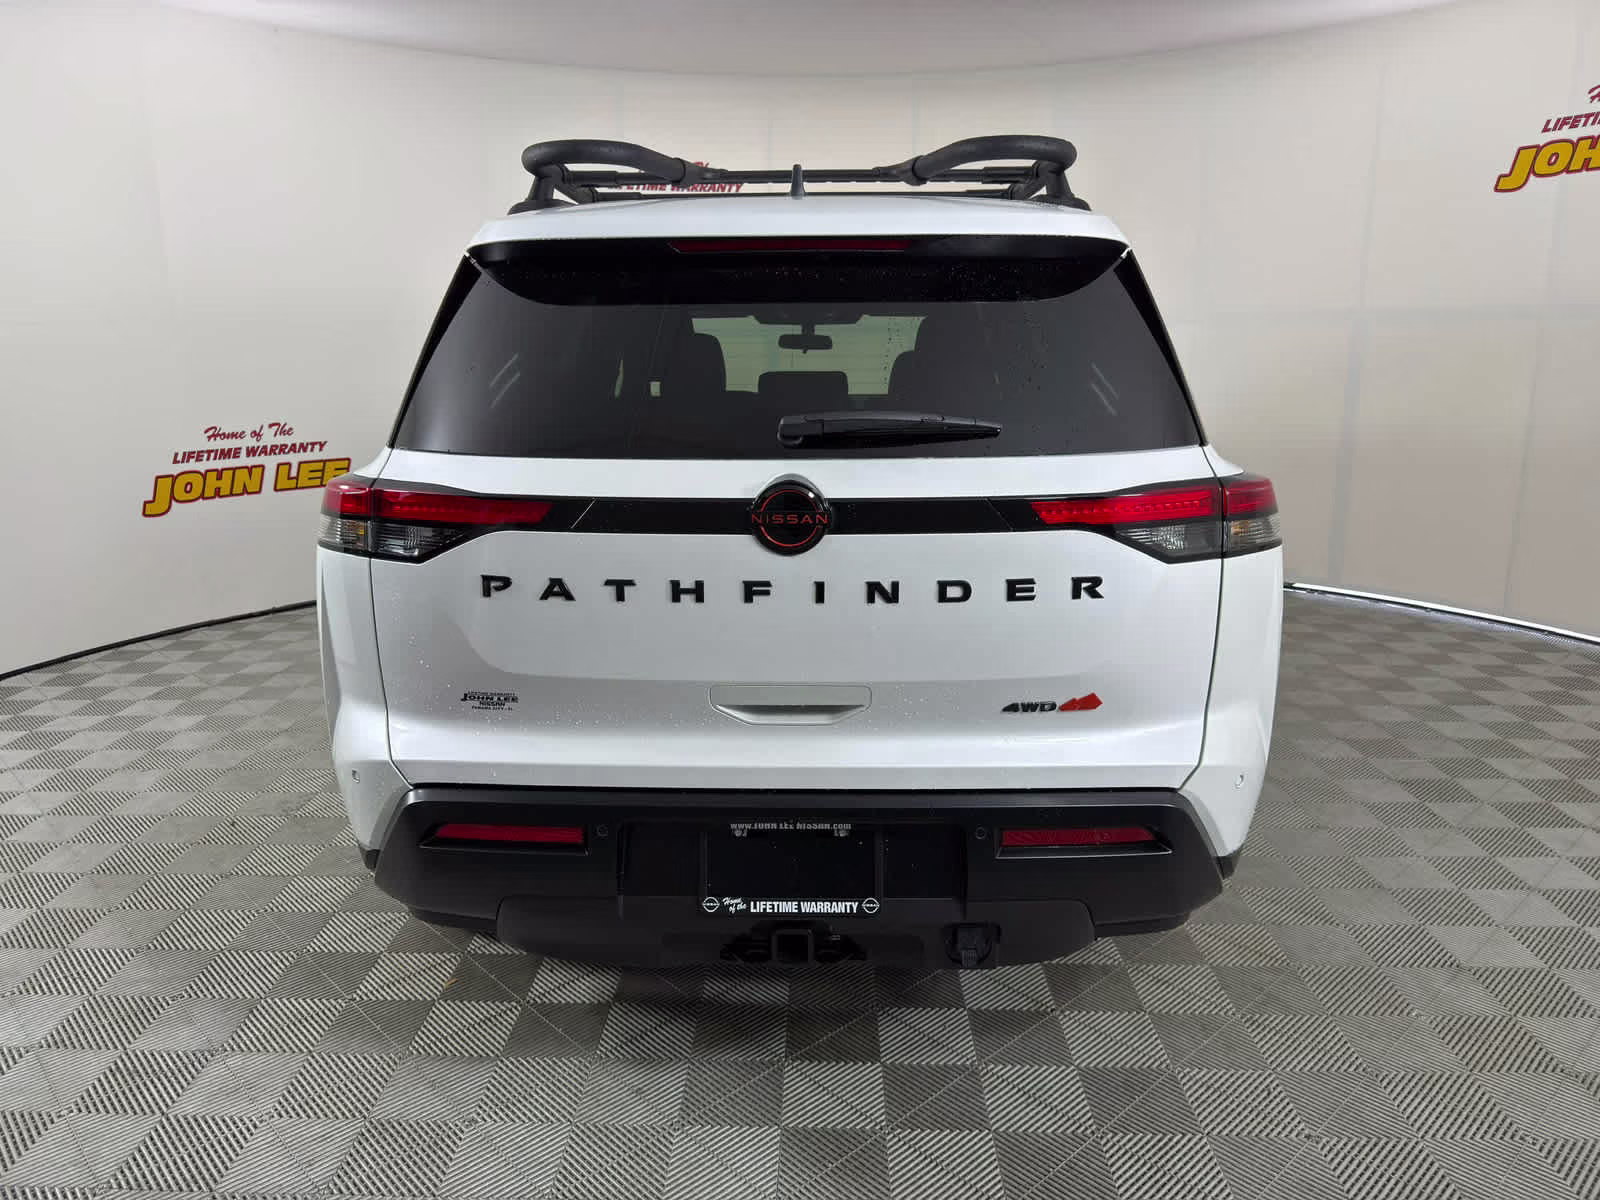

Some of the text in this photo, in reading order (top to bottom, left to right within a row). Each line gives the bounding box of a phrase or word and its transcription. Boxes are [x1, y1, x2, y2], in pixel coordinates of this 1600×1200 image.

[1541, 111, 1600, 133] LIFETI
[203, 422, 294, 441] Home of The
[172, 440, 328, 465] LIFETIME WARRANTY
[142, 464, 265, 518] JOHN
[752, 513, 829, 525] NISSAN
[480, 574, 1105, 603] PATHFINDER
[1001, 701, 1057, 713] 4WD
[750, 901, 859, 914] LIFETIME WARRANTY
